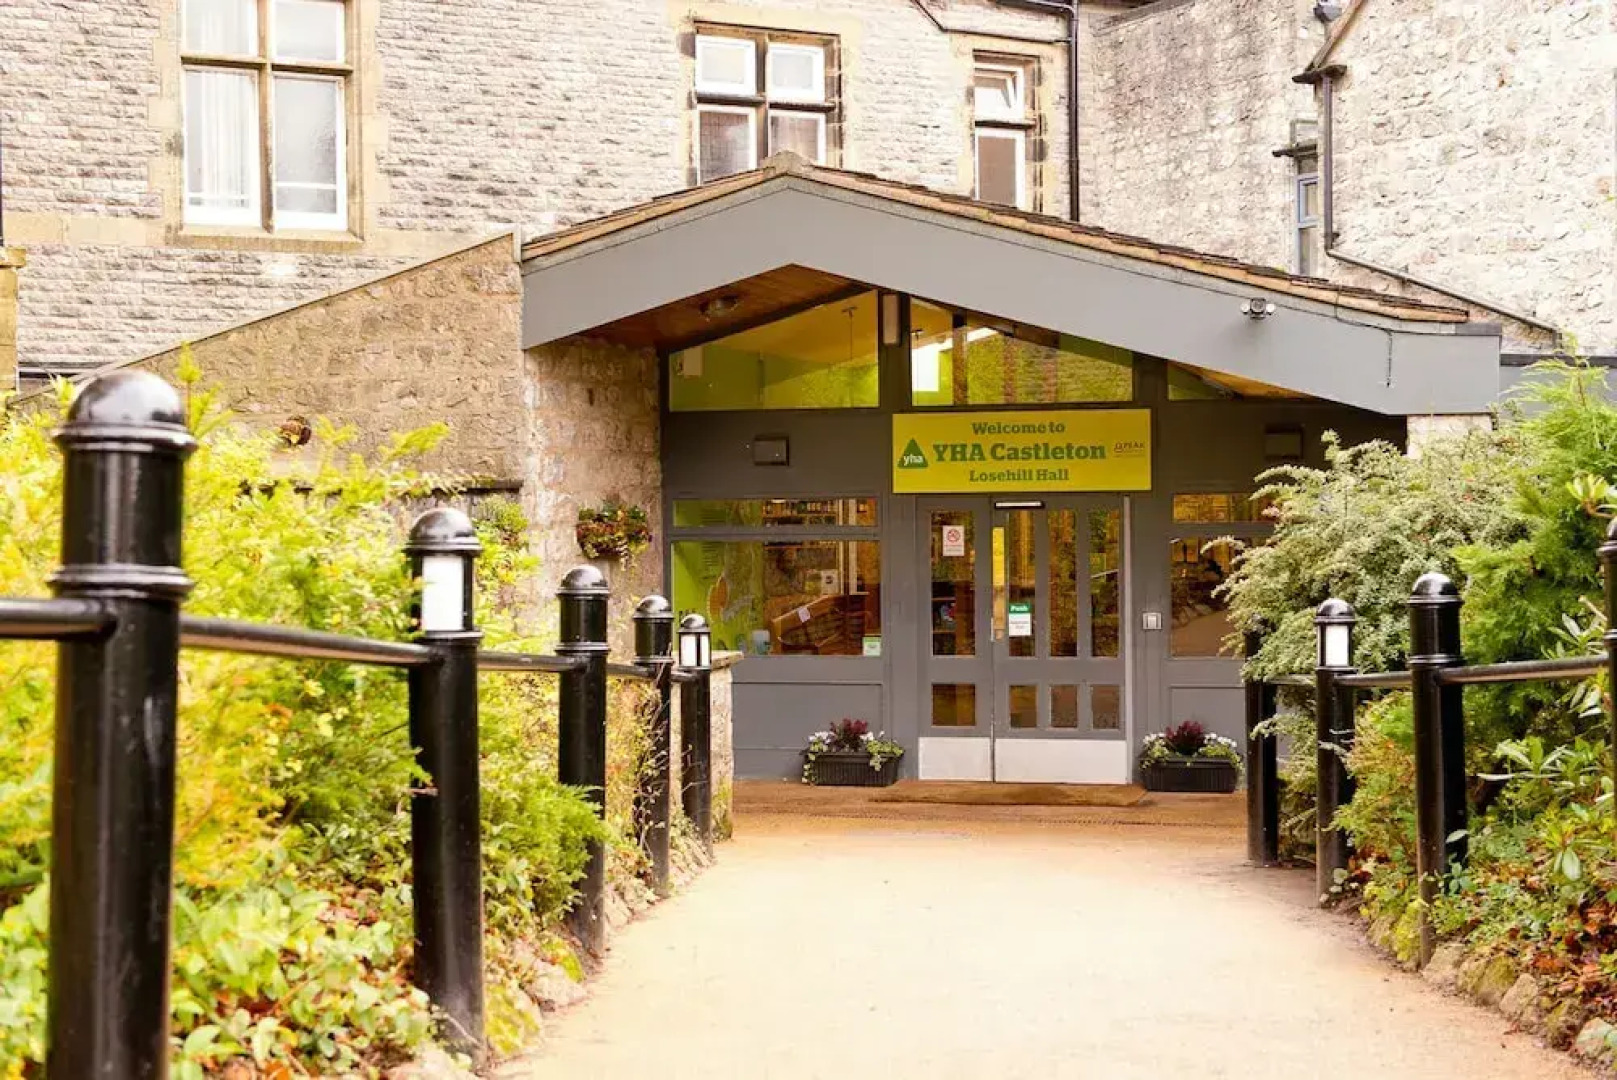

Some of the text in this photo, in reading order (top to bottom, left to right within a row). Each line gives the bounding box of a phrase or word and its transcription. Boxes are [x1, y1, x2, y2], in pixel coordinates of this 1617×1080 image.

[972, 421, 1066, 435] Welcome to
[933, 443, 987, 462] YHA
[990, 442, 1106, 461] Castleton
[902, 453, 924, 466] yha
[970, 468, 1069, 482] Losehill Hall
